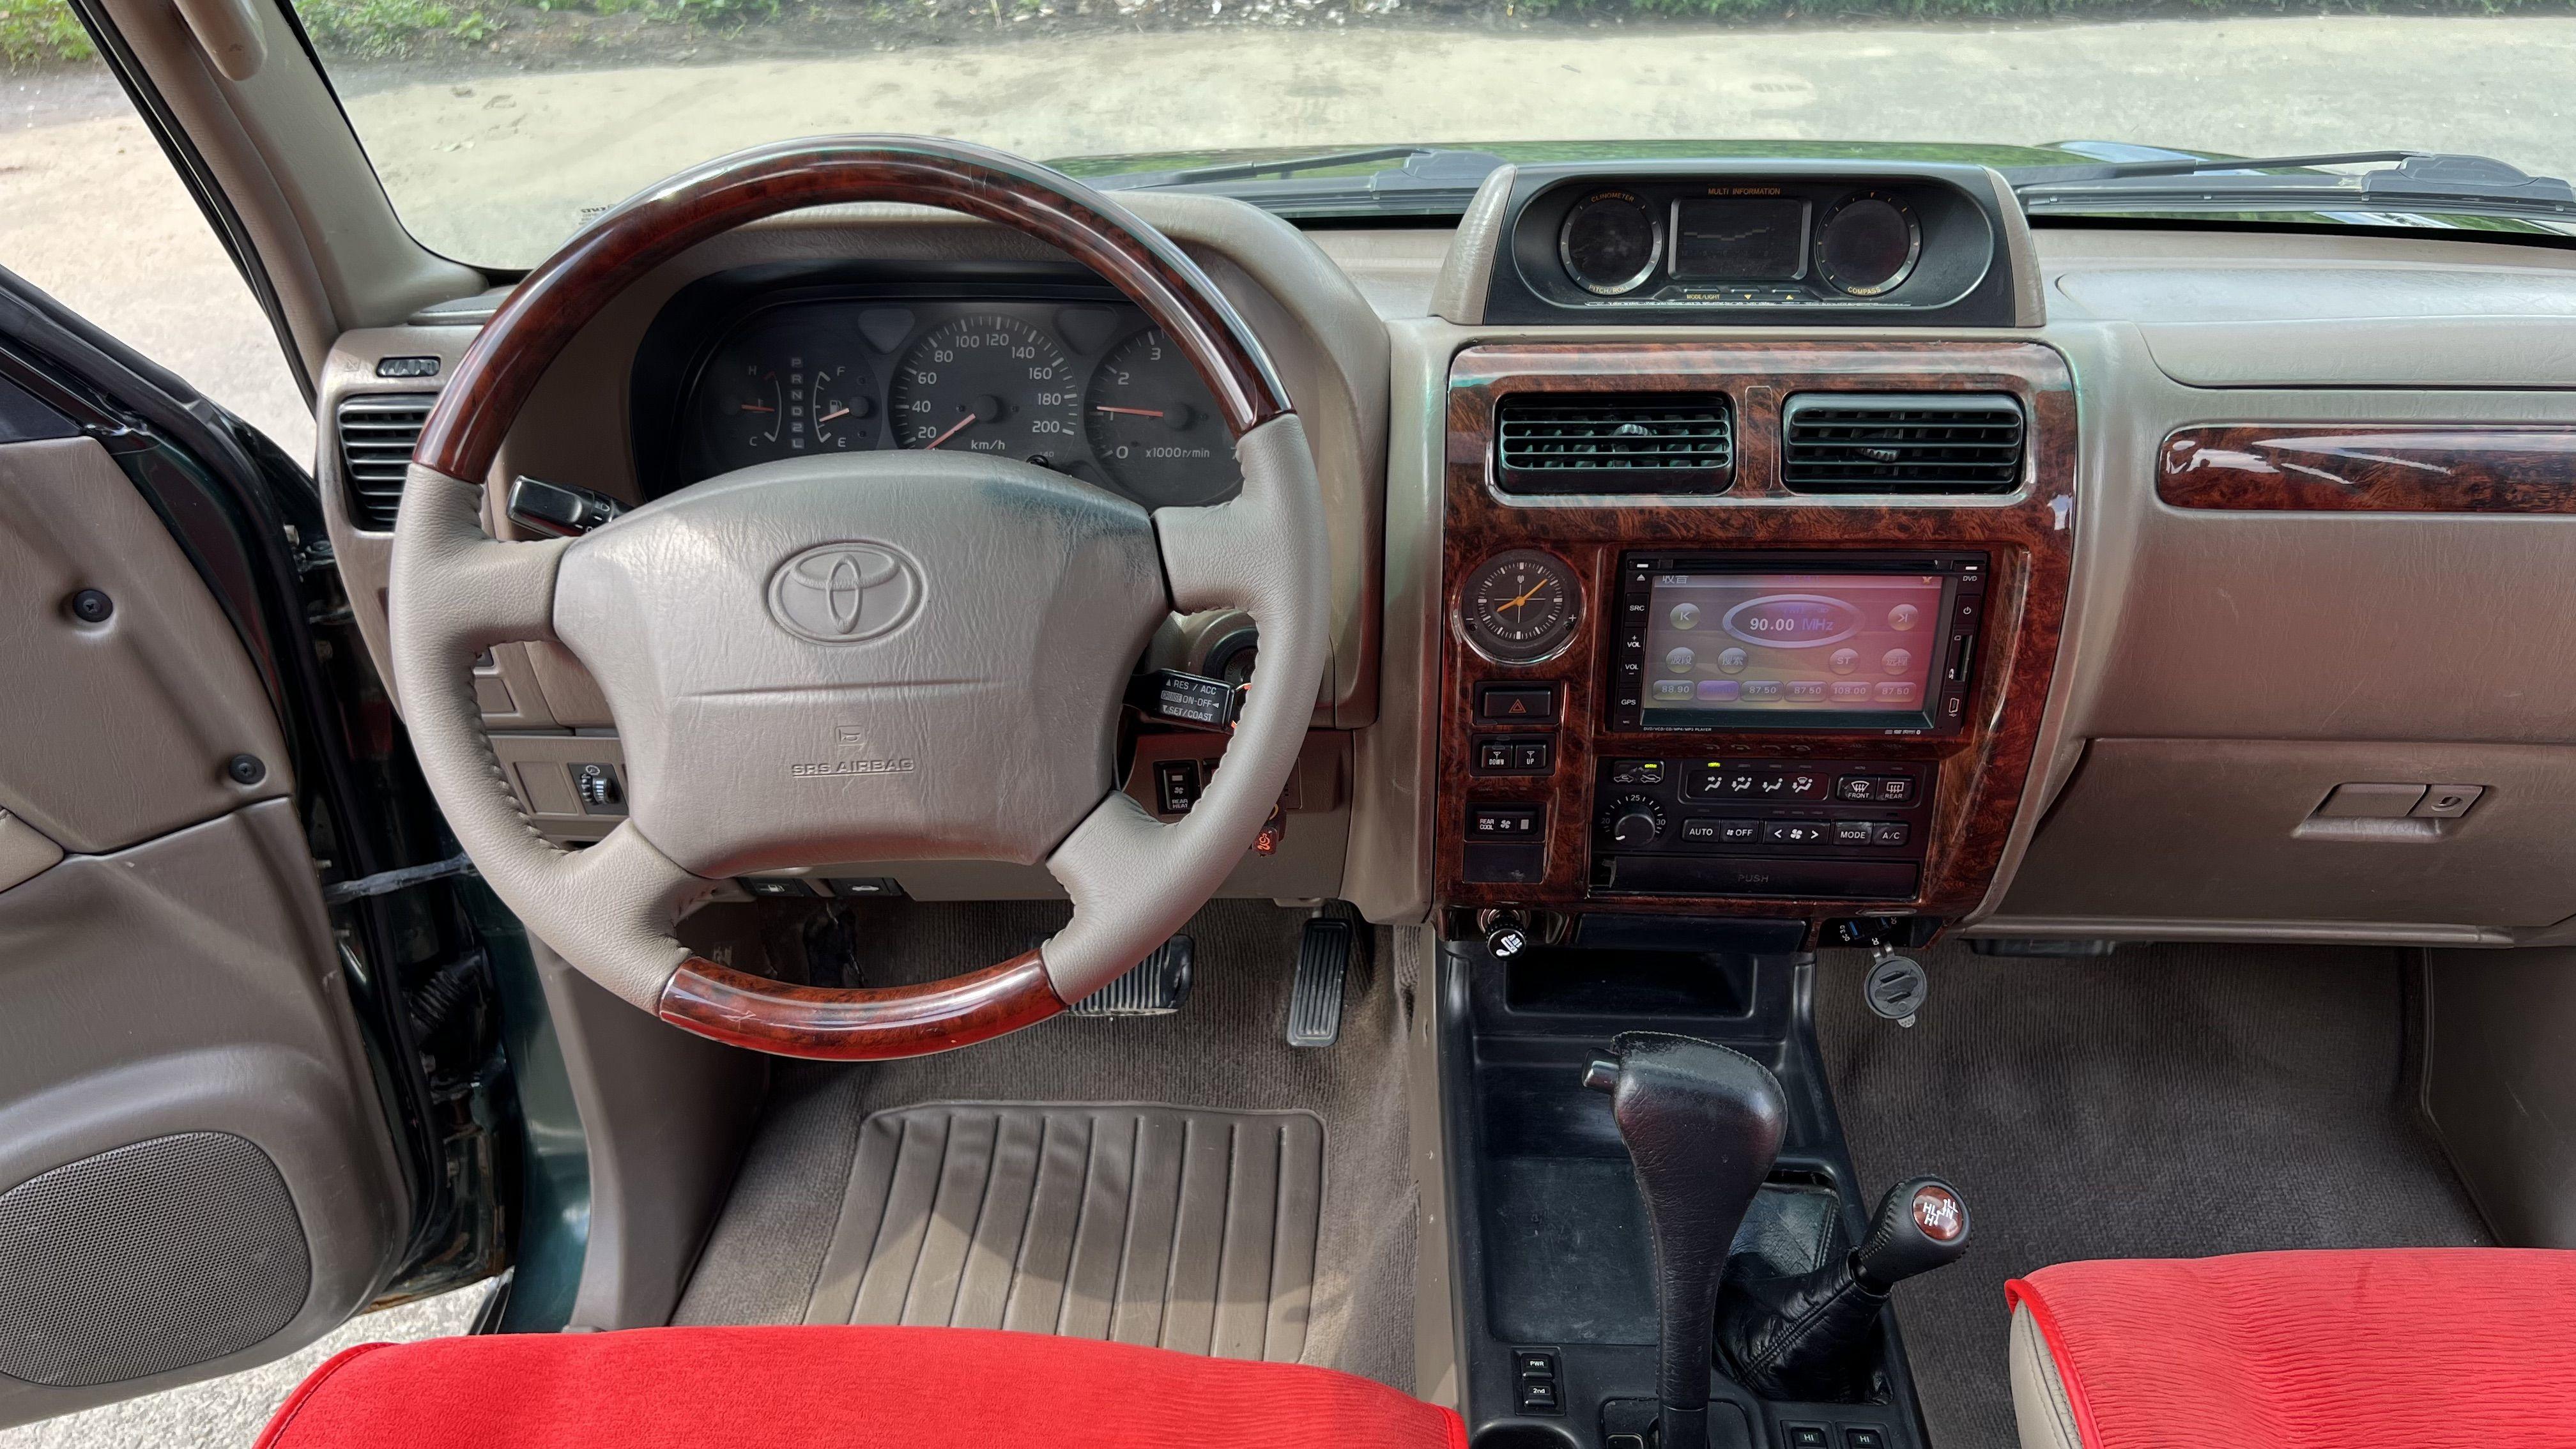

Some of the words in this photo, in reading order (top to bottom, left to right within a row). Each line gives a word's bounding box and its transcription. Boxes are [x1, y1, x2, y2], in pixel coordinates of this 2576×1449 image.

[1591, 192, 1634, 203] CLINOMETER
[1588, 284, 1629, 294] PITCH/ROLL
[1848, 286, 1881, 295] COMPASS
[956, 335, 979, 348] 100
[986, 334, 1009, 346] 120
[935, 350, 953, 362] 80
[1012, 346, 1035, 359] 140
[1150, 348, 1161, 360] 3
[792, 358, 801, 367] P
[749, 365, 756, 376] H
[837, 366, 846, 376] F
[1029, 367, 1052, 379] 160
[792, 374, 801, 383] R
[918, 372, 937, 384] 60
[1118, 372, 1130, 385] 2
[792, 390, 802, 399] N
[1038, 393, 1061, 405] 180
[792, 407, 802, 415] D
[912, 401, 931, 413] 40
[792, 424, 802, 432] 2
[918, 426, 937, 438] 20
[1032, 421, 1060, 433] 200
[749, 436, 758, 447] C
[793, 440, 803, 448] L
[838, 437, 847, 447] E
[971, 440, 1006, 450] km/h
[1116, 446, 1129, 459] 0
[1749, 617, 1794, 631] 90.00
[1802, 618, 1834, 631] MHz
[1174, 680, 1189, 690] RES
[1200, 685, 1217, 695] ACC
[1162, 691, 1182, 703] CRUISE
[1183, 695, 1213, 707] ON-OFF
[1169, 706, 1213, 721] SET/COAST
[792, 763, 831, 775] SRS
[836, 758, 914, 773] AIRBAG
[1738, 874, 1768, 882] PUSH
